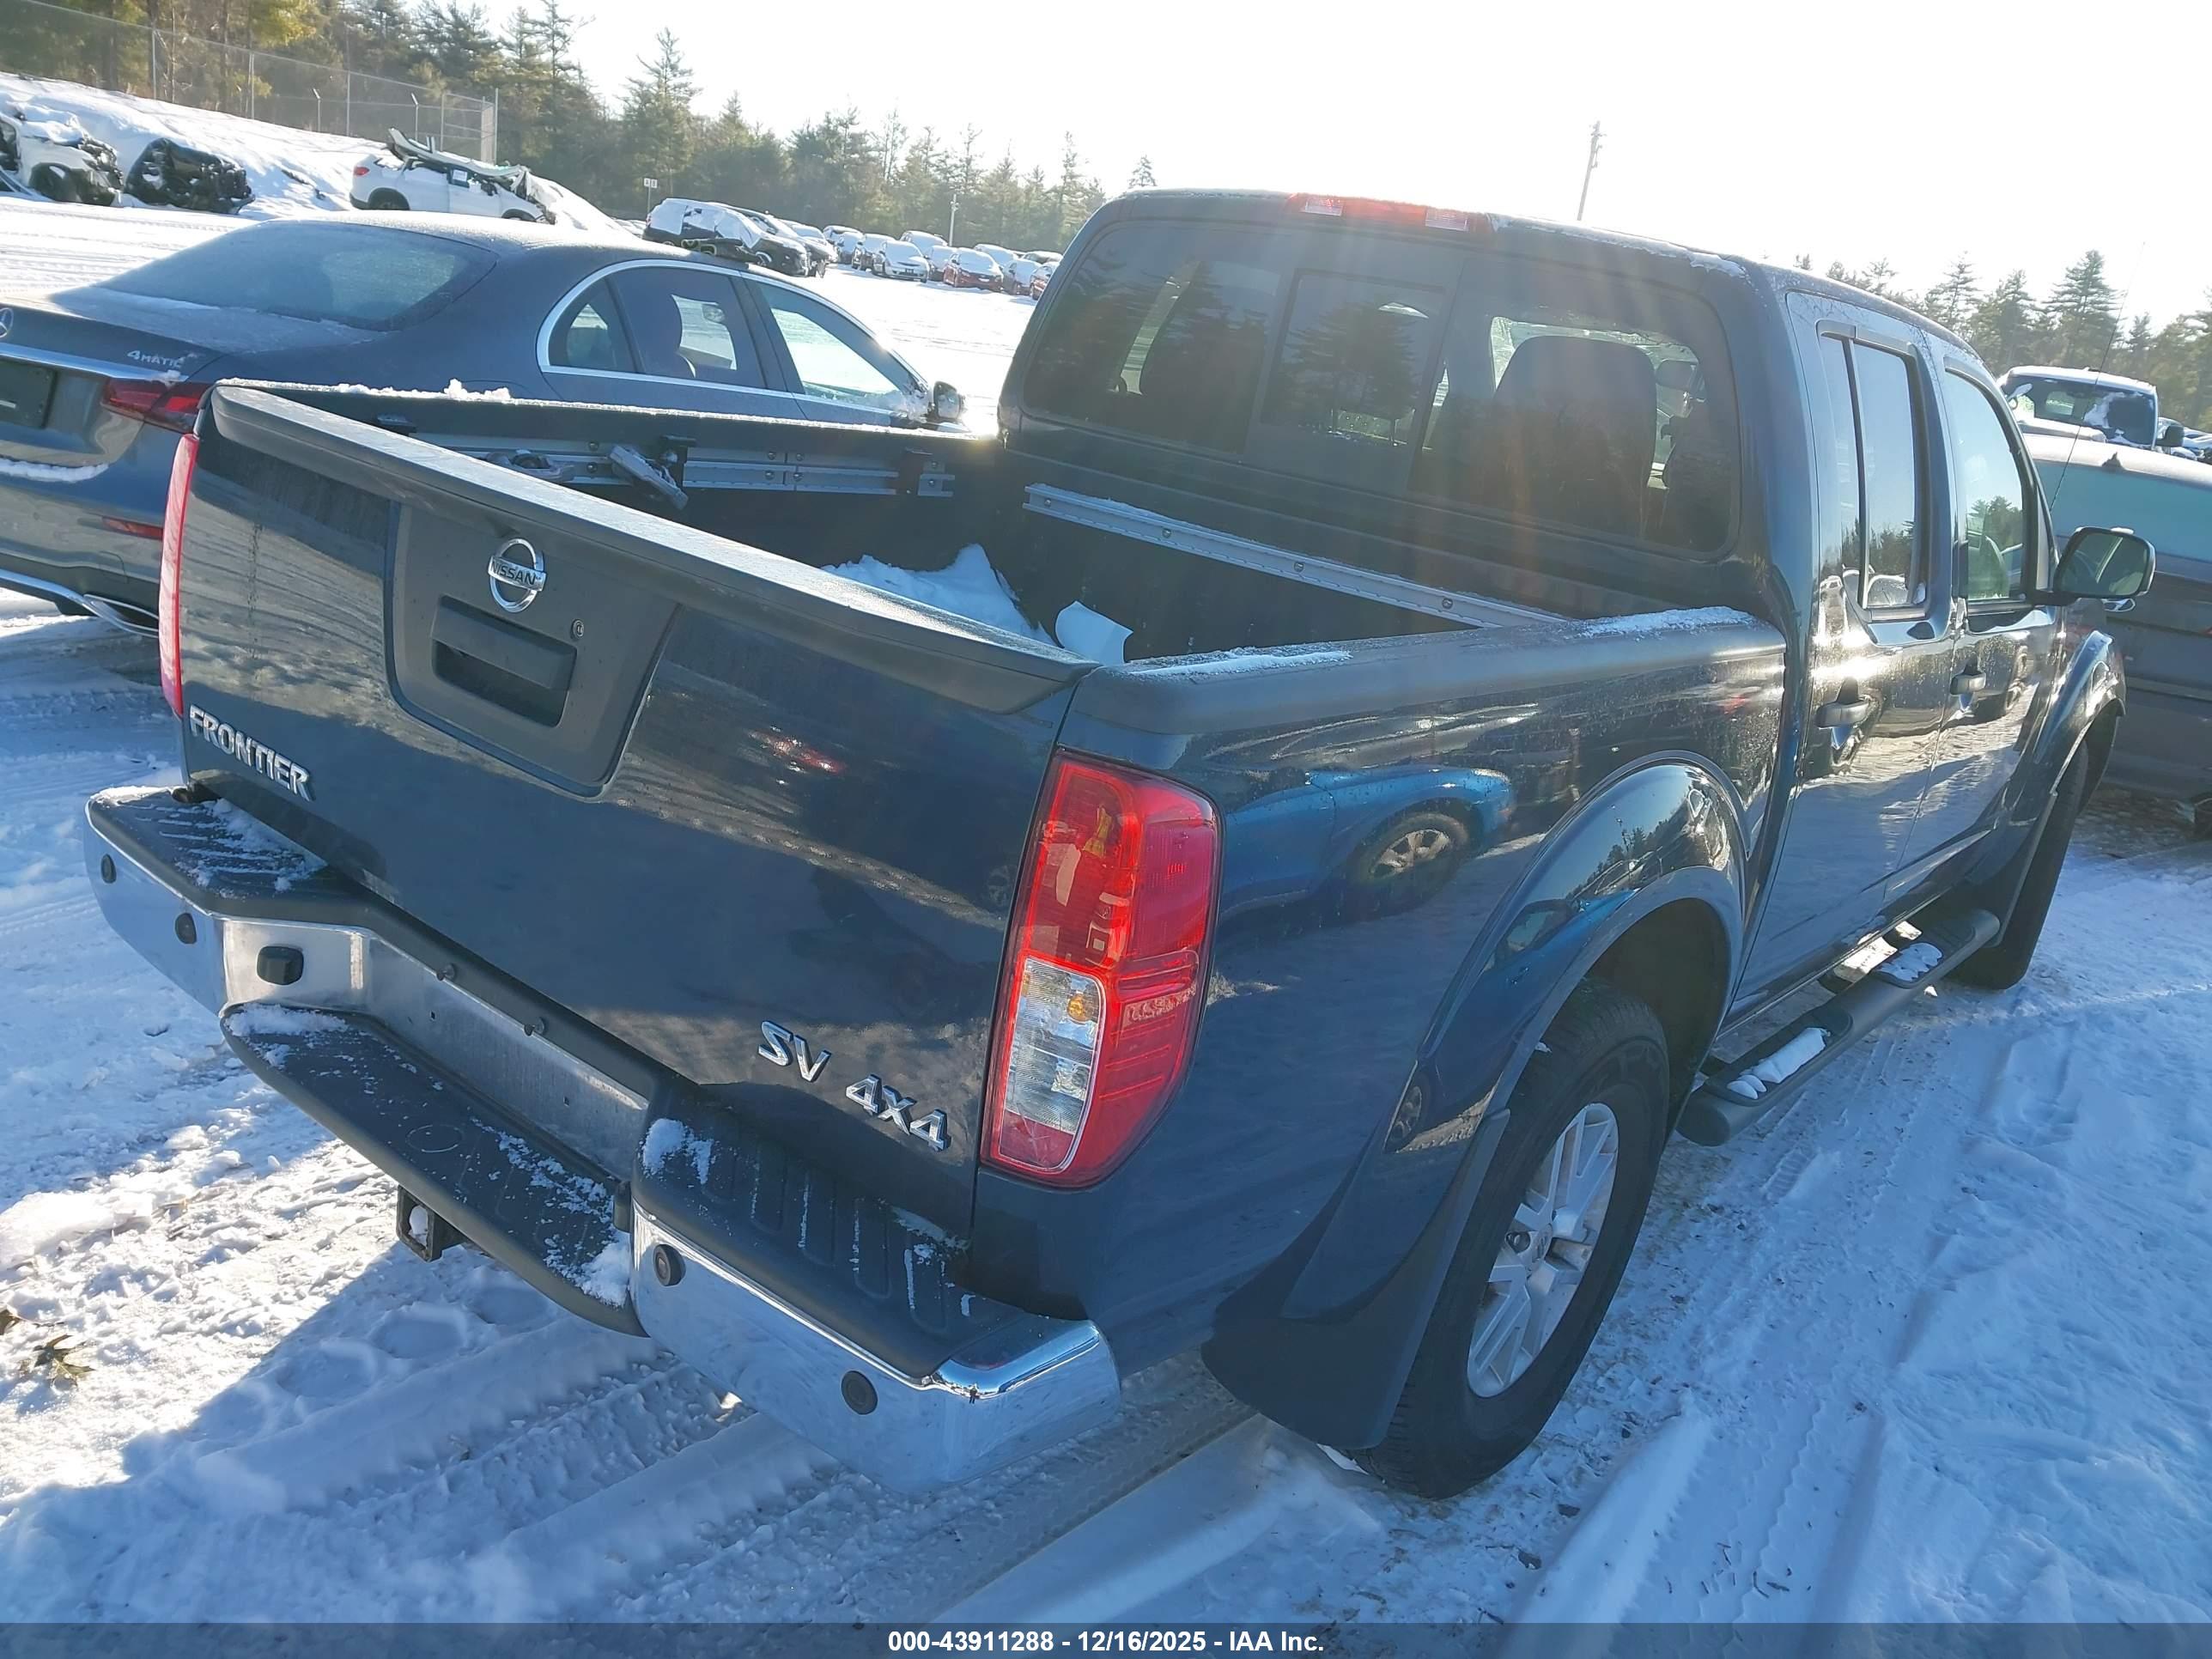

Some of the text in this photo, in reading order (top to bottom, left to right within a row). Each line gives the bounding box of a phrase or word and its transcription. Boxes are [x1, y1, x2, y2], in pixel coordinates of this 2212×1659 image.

[127, 350, 185, 368] 4MATIC
[490, 559, 537, 586] NISSAN
[189, 704, 311, 802] FRONTIER
[757, 1020, 832, 1083] SV
